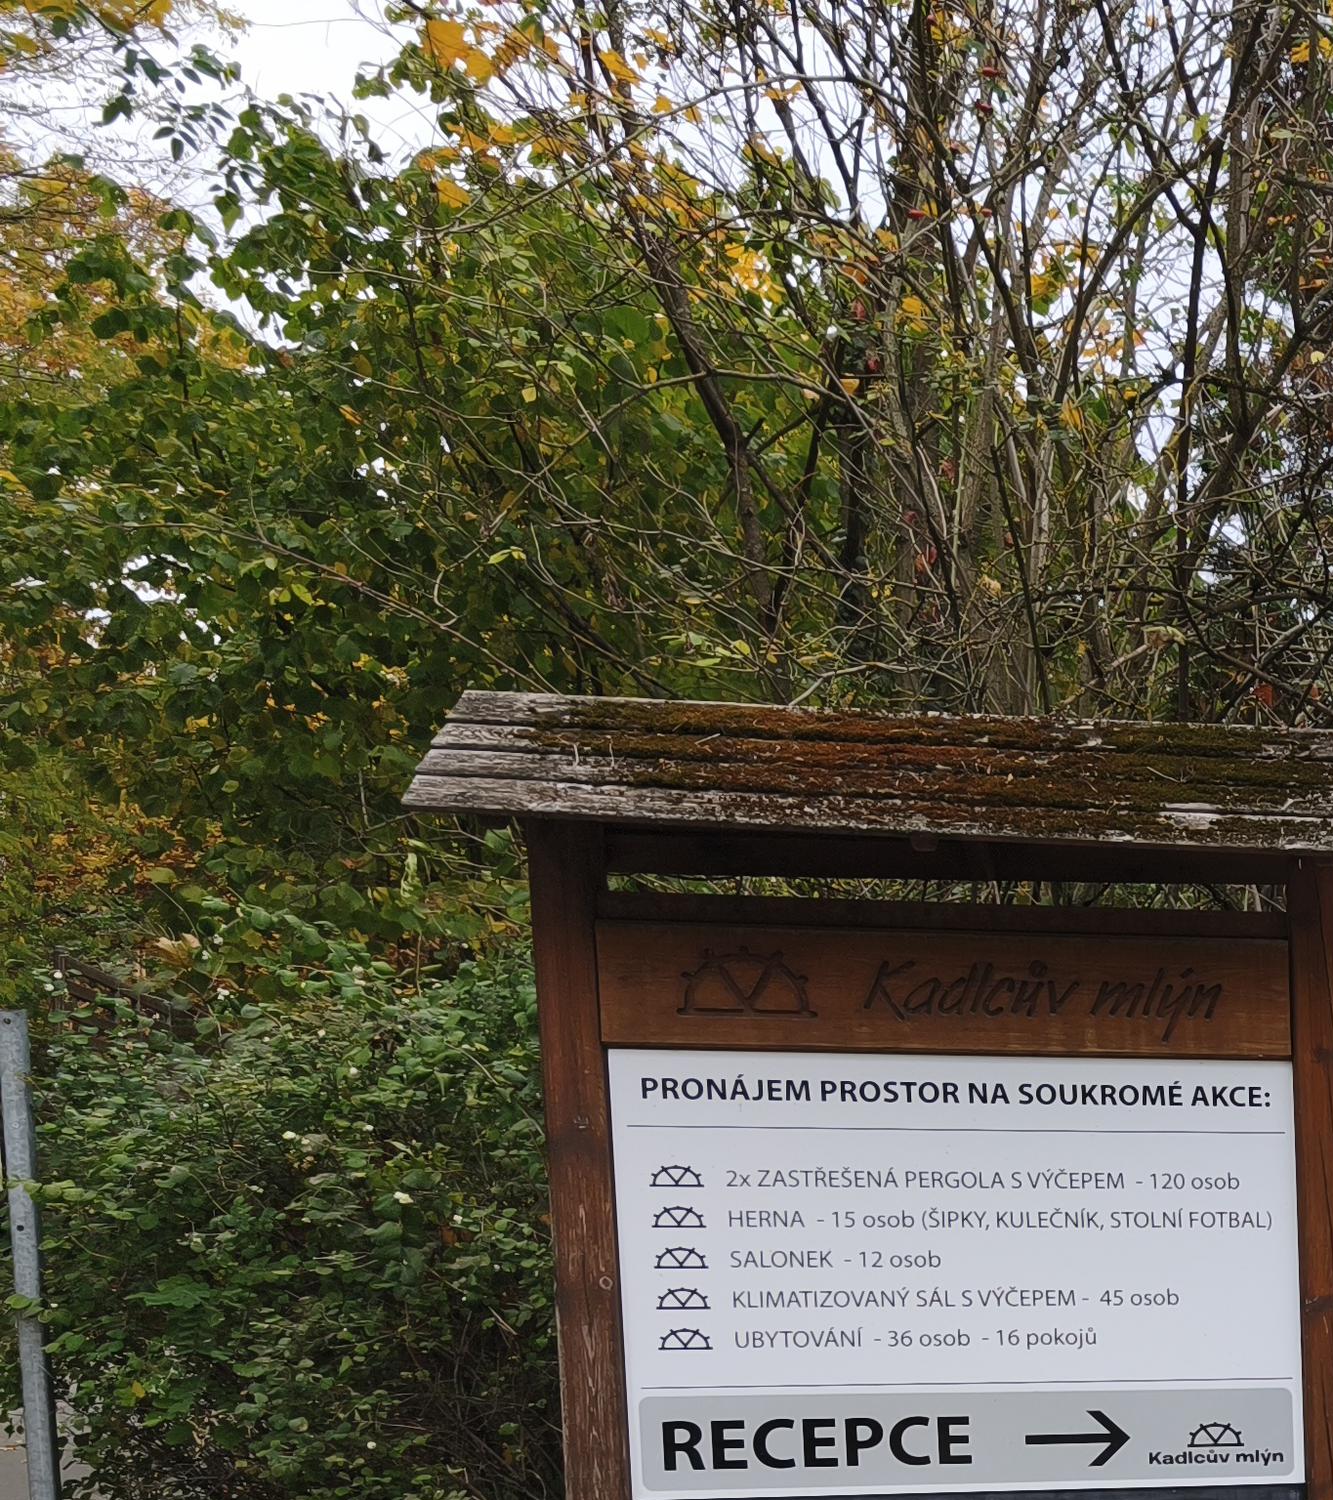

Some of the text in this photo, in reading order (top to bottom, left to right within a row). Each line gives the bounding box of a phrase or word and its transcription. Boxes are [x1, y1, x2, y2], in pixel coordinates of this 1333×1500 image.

[863, 959, 1223, 1043] Kadlcův mlýn
[640, 1073, 1271, 1108] PRONÁJEM PROSTOR NA SOUKROMÉ AKCE:
[725, 1169, 752, 1188] 2x
[757, 1166, 899, 1189] ZASTŘEŠENÁ
[904, 1170, 1006, 1190] PERGOLA
[1010, 1171, 1023, 1190] S
[1026, 1168, 1126, 1190] VÝČEPEM
[1149, 1172, 1186, 1190] 120
[1190, 1171, 1241, 1191] osob
[727, 1209, 806, 1228] HERNA
[831, 1211, 856, 1229] 15
[862, 1209, 915, 1229] osob
[921, 1207, 991, 1232] (ŠIPKY,
[996, 1207, 1105, 1231] KULEČNÍK,
[1110, 1207, 1184, 1229] STOLNÍ
[1188, 1210, 1274, 1231] FOTBAL)
[730, 1250, 834, 1269] SALONEK
[858, 1250, 884, 1269] 12
[889, 1249, 942, 1269] osob
[732, 1286, 910, 1309] KLIMATIZOVANÝ
[916, 1286, 957, 1308] SÁL
[961, 1289, 974, 1308] S
[977, 1286, 1077, 1308] VÝČEPEM
[1099, 1289, 1124, 1307] 45
[1130, 1287, 1181, 1307] osob
[734, 1326, 864, 1349] UBYTOVÁNÍ
[887, 1329, 913, 1348] 36
[919, 1328, 971, 1348] osob
[996, 1328, 1021, 1347] 16
[1026, 1326, 1098, 1351] pokojů
[661, 1415, 973, 1472] RECEPCE
[1148, 1448, 1284, 1466] Kadlcův mlýn
